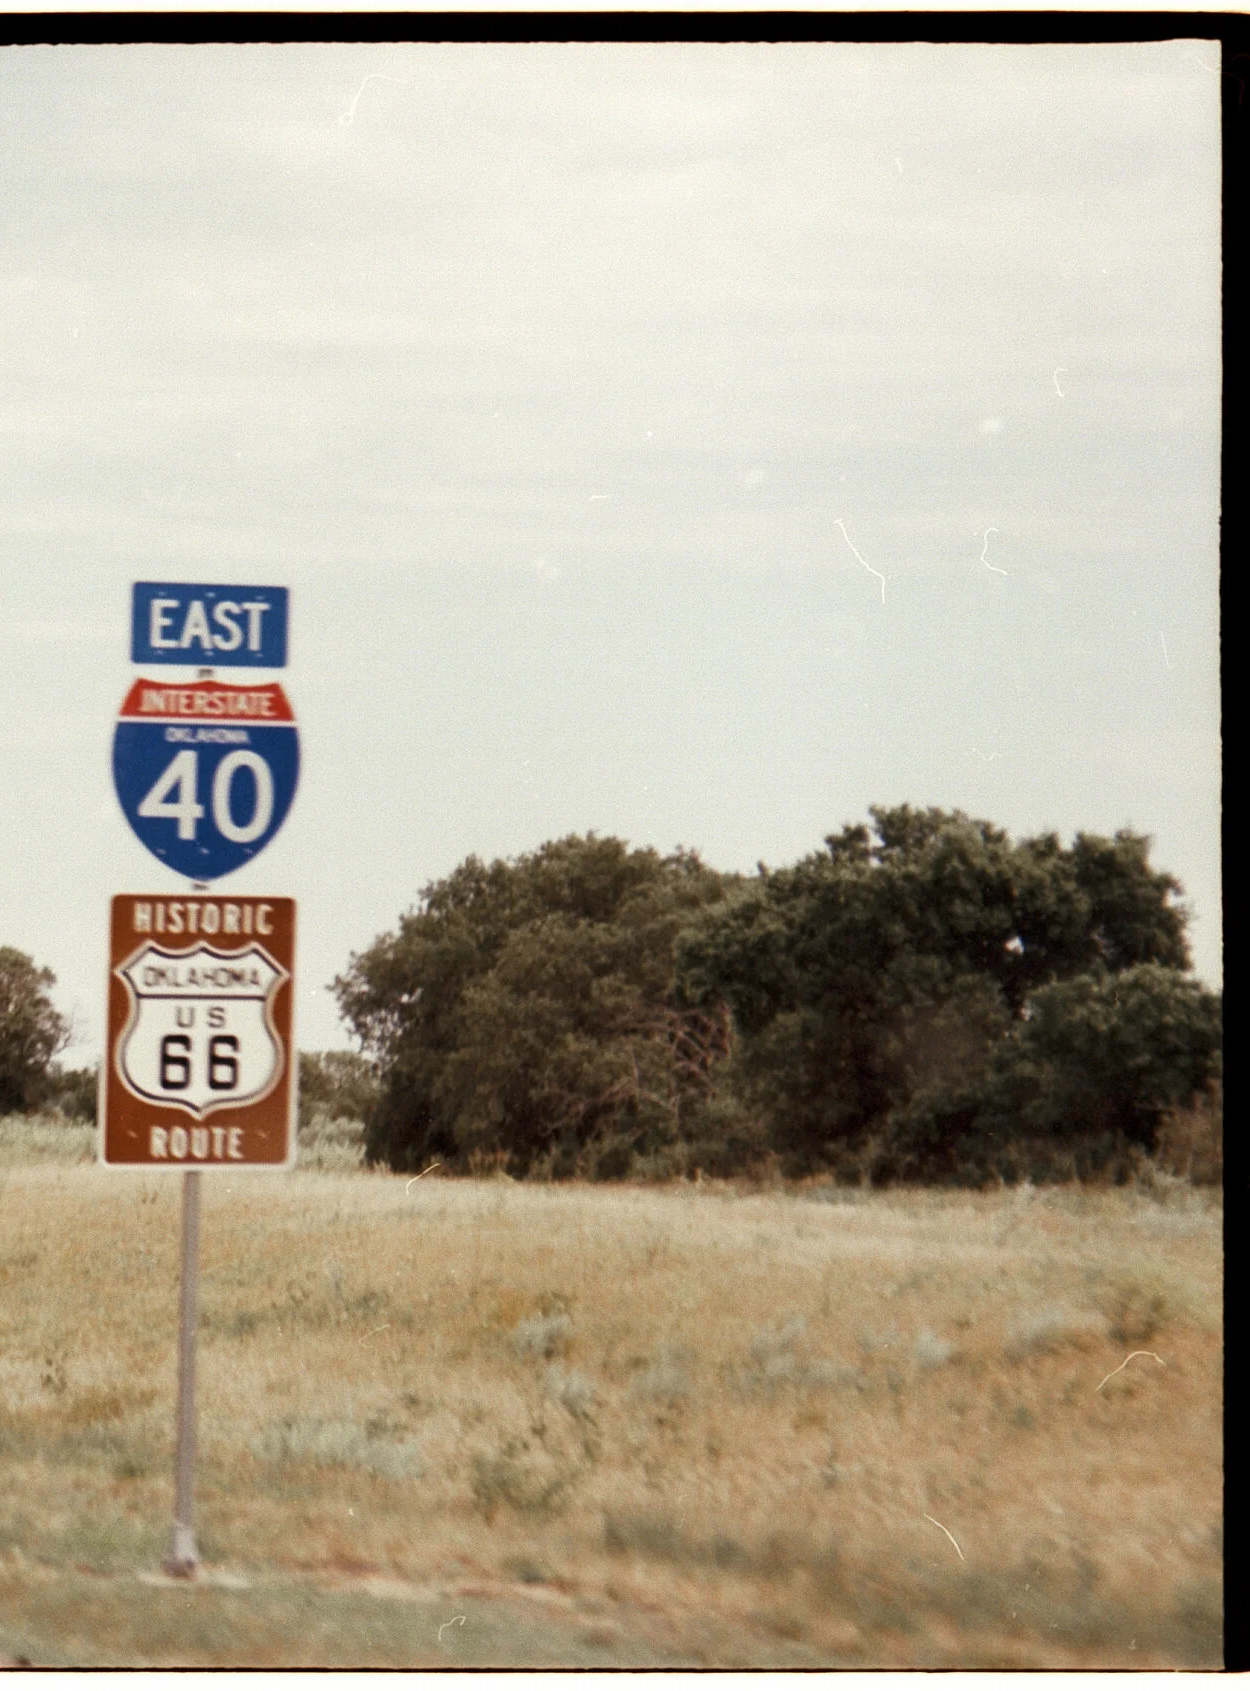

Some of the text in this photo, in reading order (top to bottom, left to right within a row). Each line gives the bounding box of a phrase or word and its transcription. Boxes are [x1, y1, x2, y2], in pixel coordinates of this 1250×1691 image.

[150, 599, 271, 651] EAST
[139, 689, 278, 716] INTERSTATE
[138, 750, 274, 843] 40
[133, 902, 273, 935] HISTORIC
[143, 966, 260, 987] OKLAHOMA
[160, 1034, 239, 1090] 66
[150, 1126, 243, 1159] ROUTE
